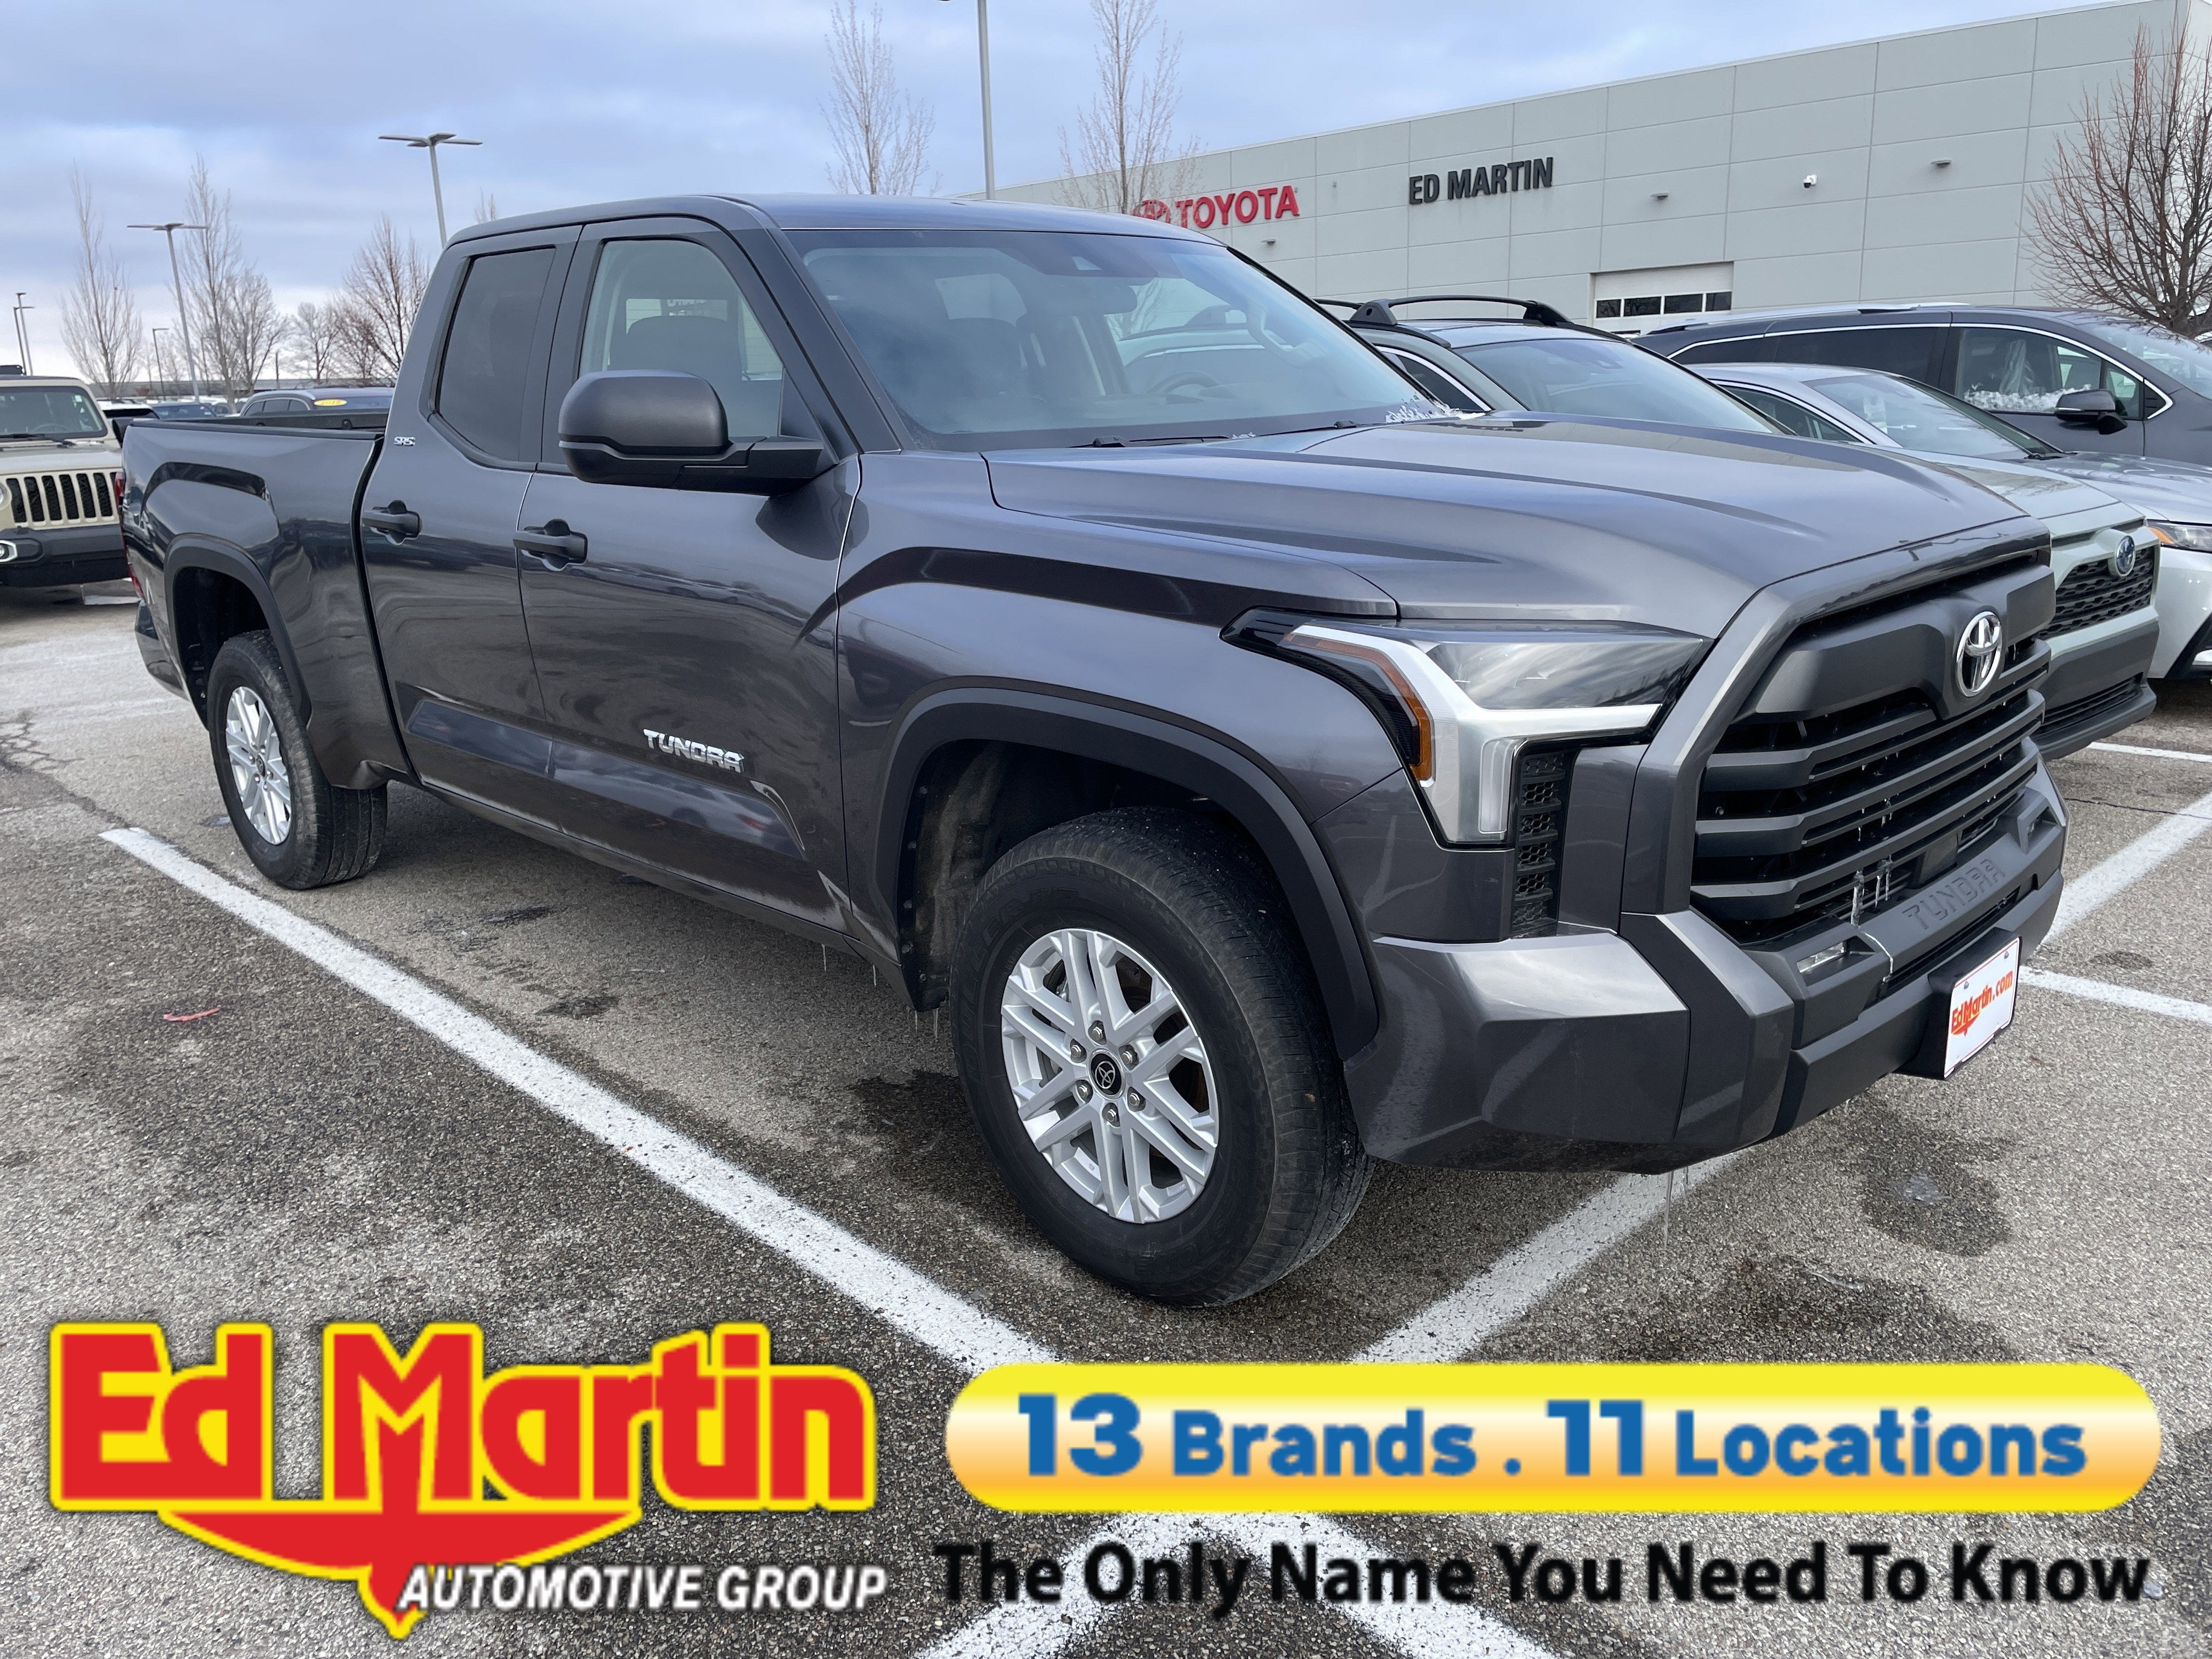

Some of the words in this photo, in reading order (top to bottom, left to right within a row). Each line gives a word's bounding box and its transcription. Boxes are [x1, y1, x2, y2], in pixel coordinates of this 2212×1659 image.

[1409, 174, 1440, 205] ED
[1447, 157, 1553, 200] MARTIN
[1175, 185, 1300, 228] TOYOTA
[643, 729, 744, 774] TUNDRA
[1902, 858, 2006, 930] TUNDRA
